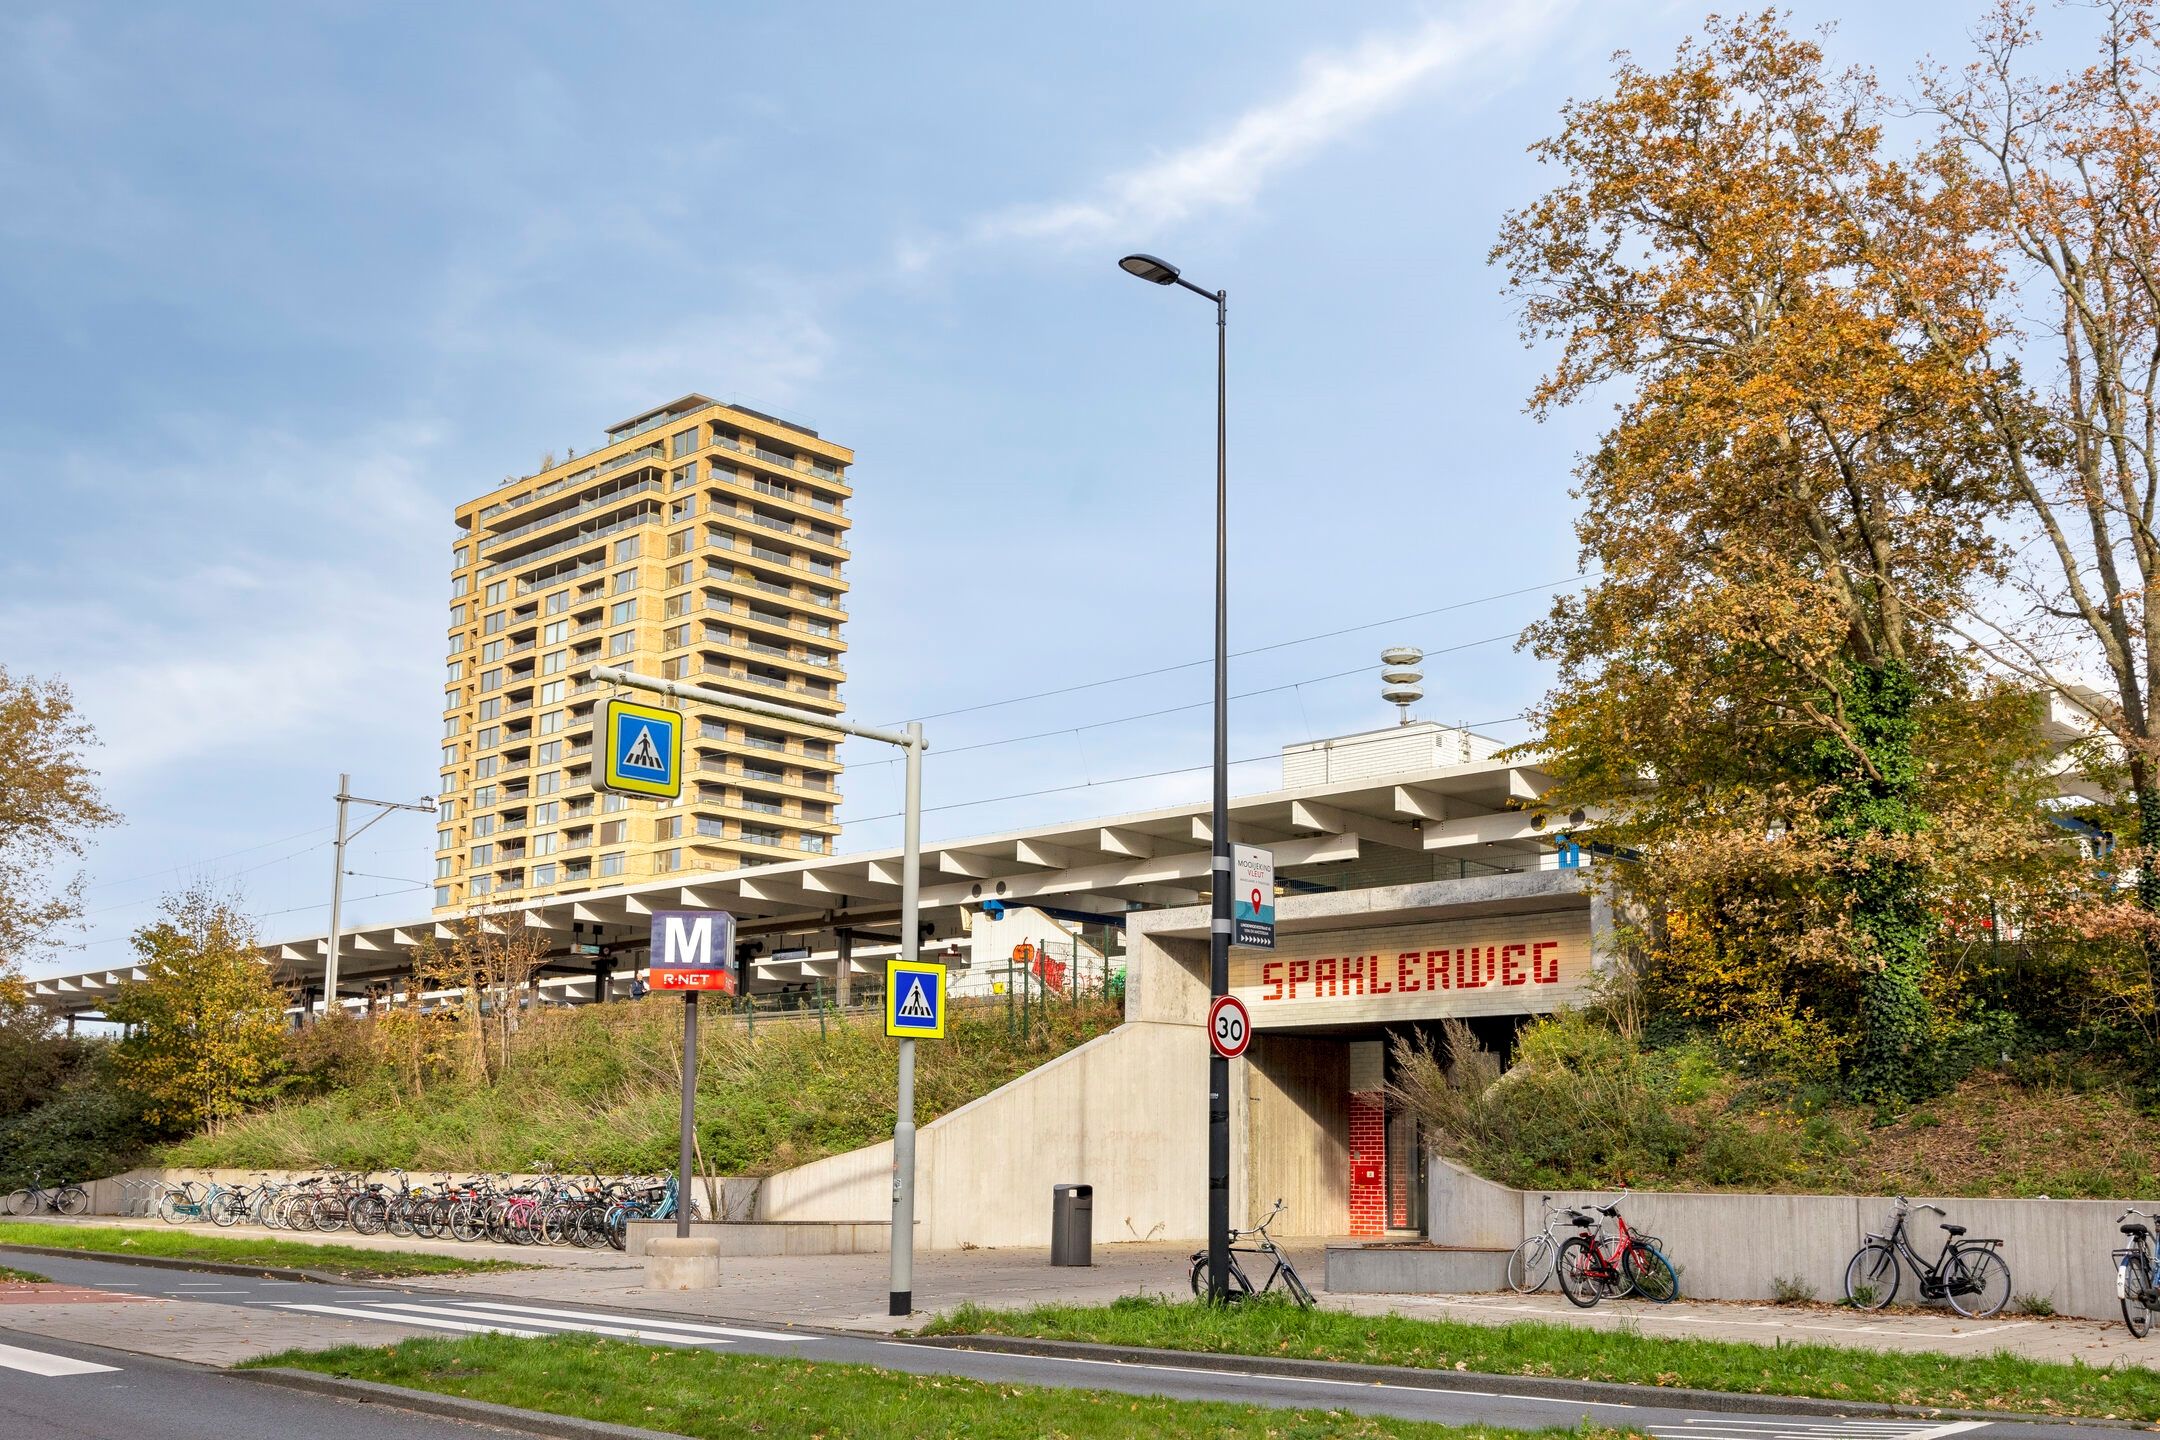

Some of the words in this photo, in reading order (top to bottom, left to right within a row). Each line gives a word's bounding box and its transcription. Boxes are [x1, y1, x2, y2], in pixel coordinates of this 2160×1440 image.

[1247, 869, 1264, 878] VLEUT
[664, 917, 712, 963] M
[1263, 941, 1558, 1001] SPAKLERWEG
[1217, 1017, 1242, 1041] 30
